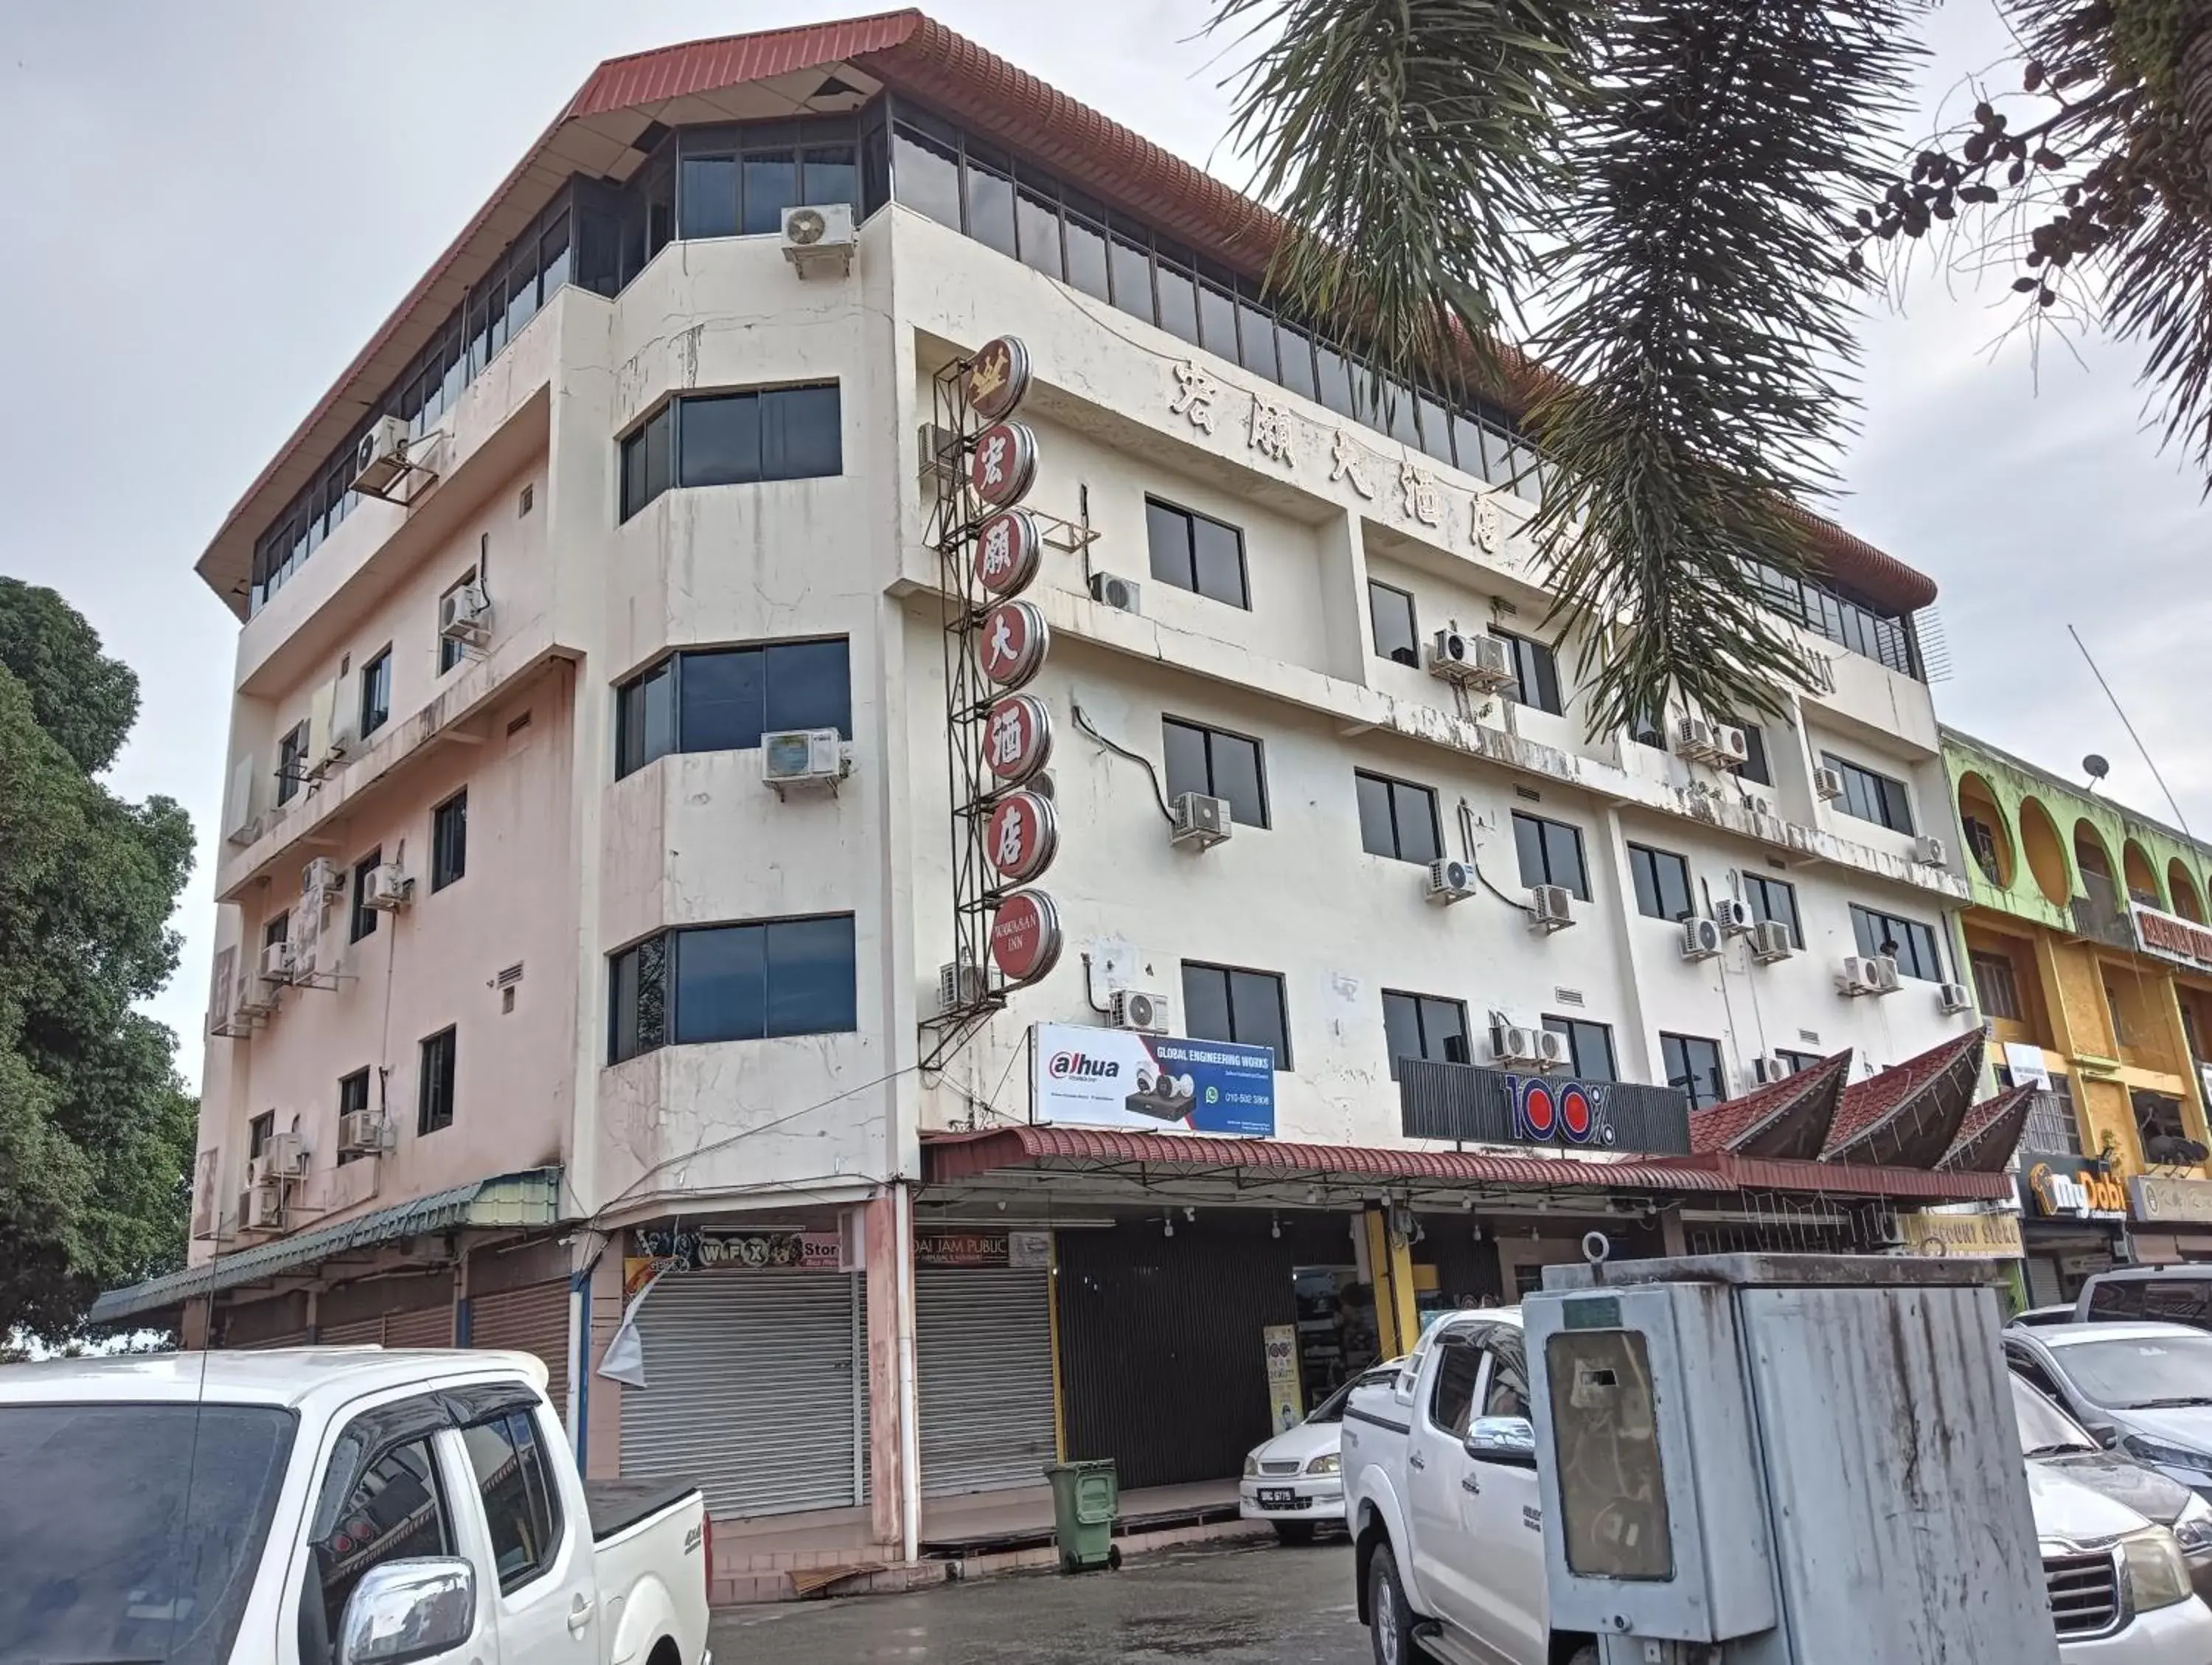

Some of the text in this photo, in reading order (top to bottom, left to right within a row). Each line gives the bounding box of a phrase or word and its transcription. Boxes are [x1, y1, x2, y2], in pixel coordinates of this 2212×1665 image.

[1007, 934, 1023, 952] INN
[1156, 1046, 1269, 1069] GLOBAL ENGINEERING WORKS
[1505, 1074, 1615, 1146] 100%
[804, 1242, 839, 1256] Stor
[936, 1238, 964, 1254] JAM
[967, 1238, 1007, 1254] PUBLIC
